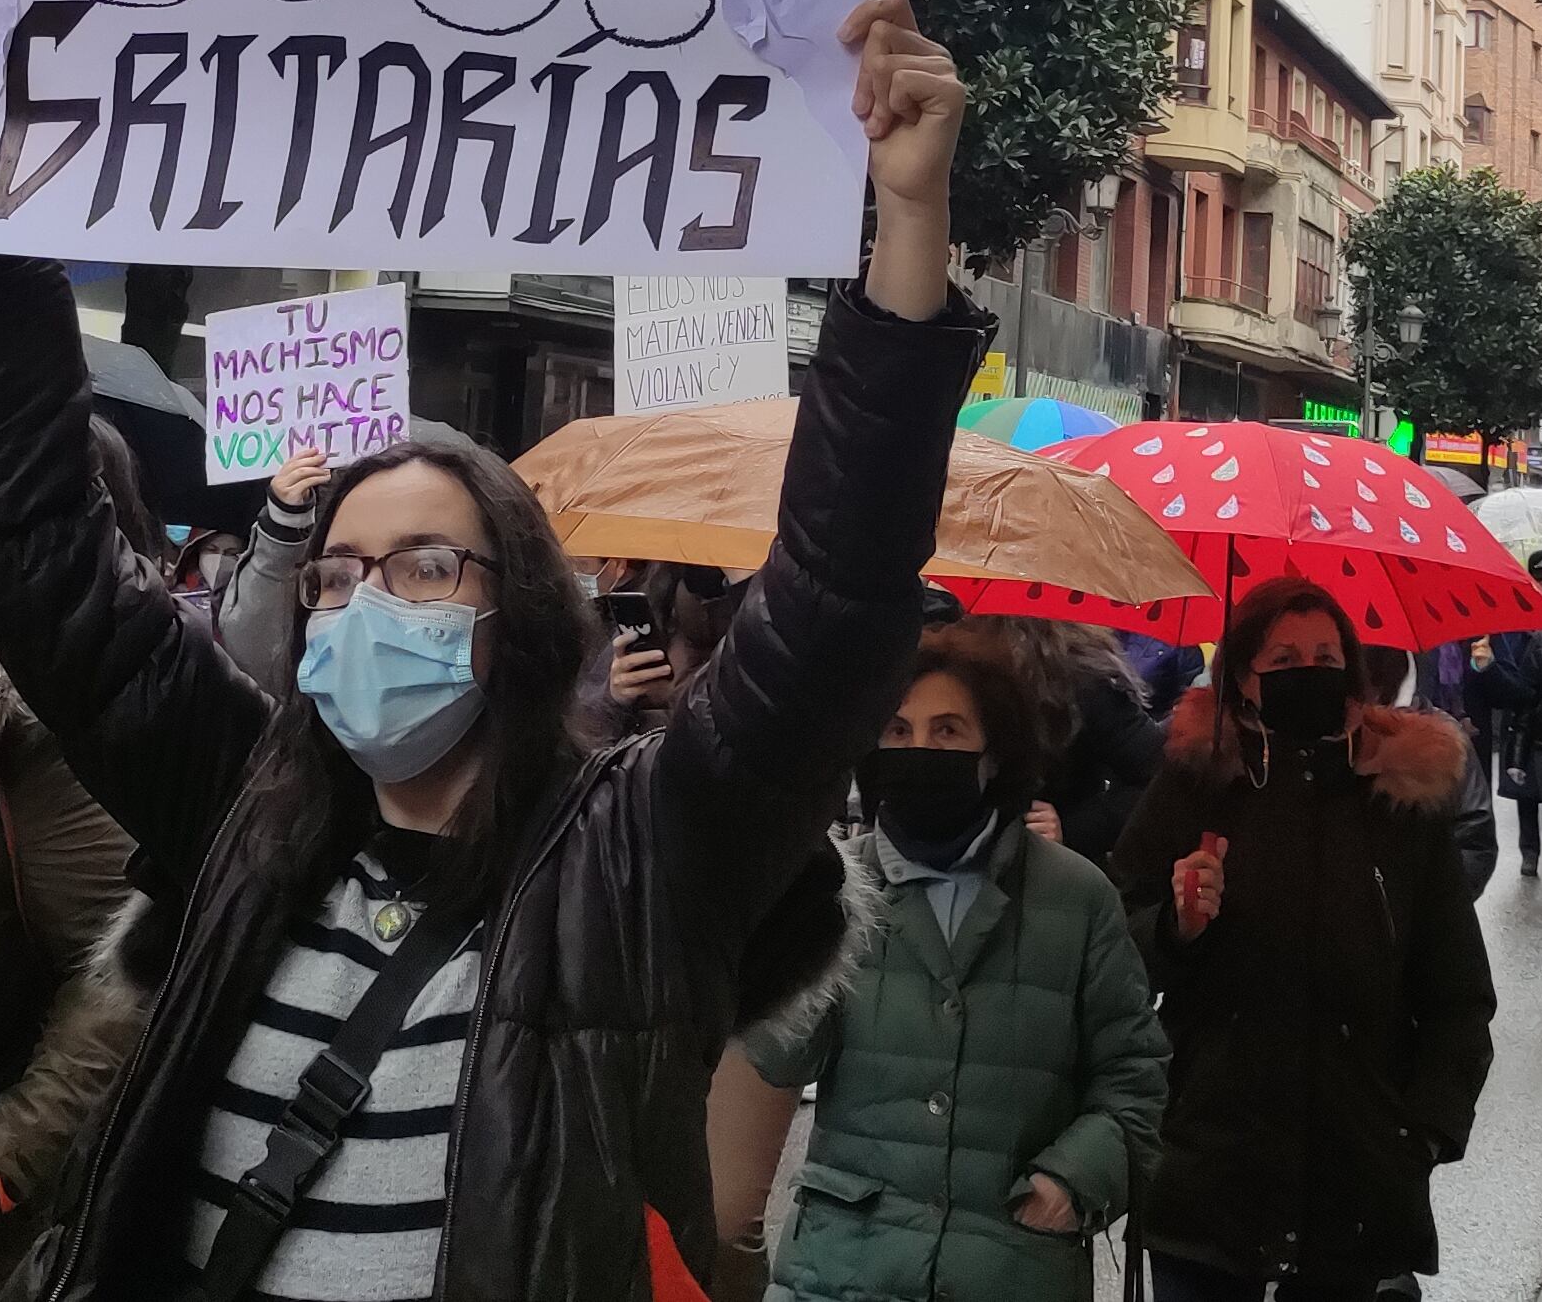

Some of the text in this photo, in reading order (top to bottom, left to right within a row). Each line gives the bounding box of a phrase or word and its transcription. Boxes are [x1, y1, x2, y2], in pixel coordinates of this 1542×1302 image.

[276, 299, 328, 336] TU
[213, 326, 404, 388] MACHISMO
[216, 373, 395, 430] NOS HACE
[627, 361, 704, 407] VIOLAN
